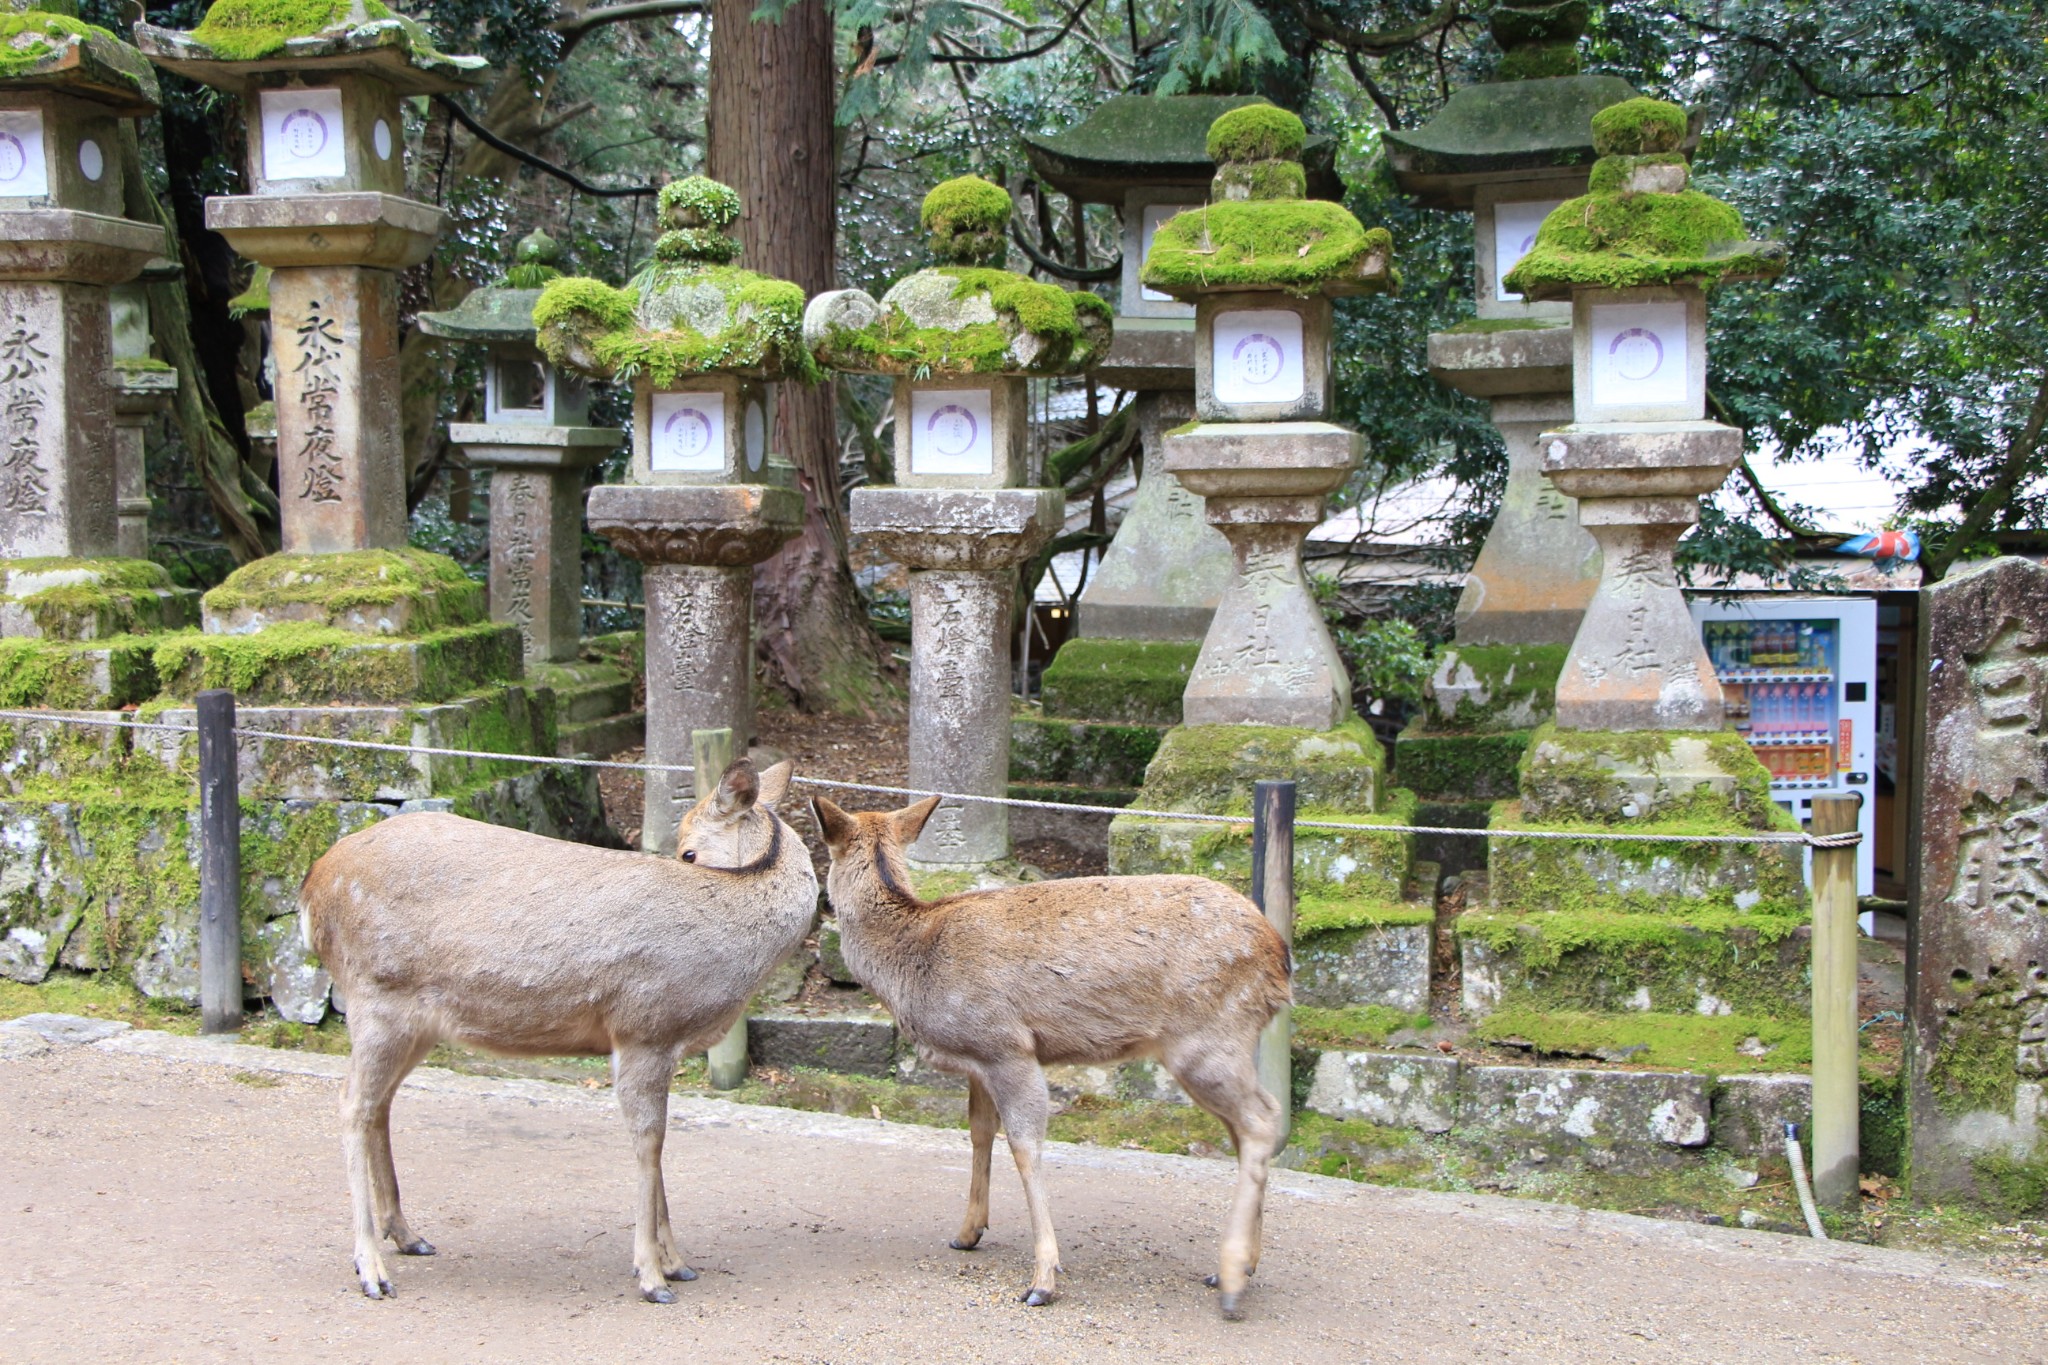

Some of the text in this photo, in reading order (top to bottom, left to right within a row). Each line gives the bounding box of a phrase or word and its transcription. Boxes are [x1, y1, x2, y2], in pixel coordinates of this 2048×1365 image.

[1, 315, 50, 516] 永代常夜燈
[293, 300, 344, 504] 永代常夜燈
[1236, 548, 1297, 670] 春日社
[1611, 549, 1675, 673] 春日社
